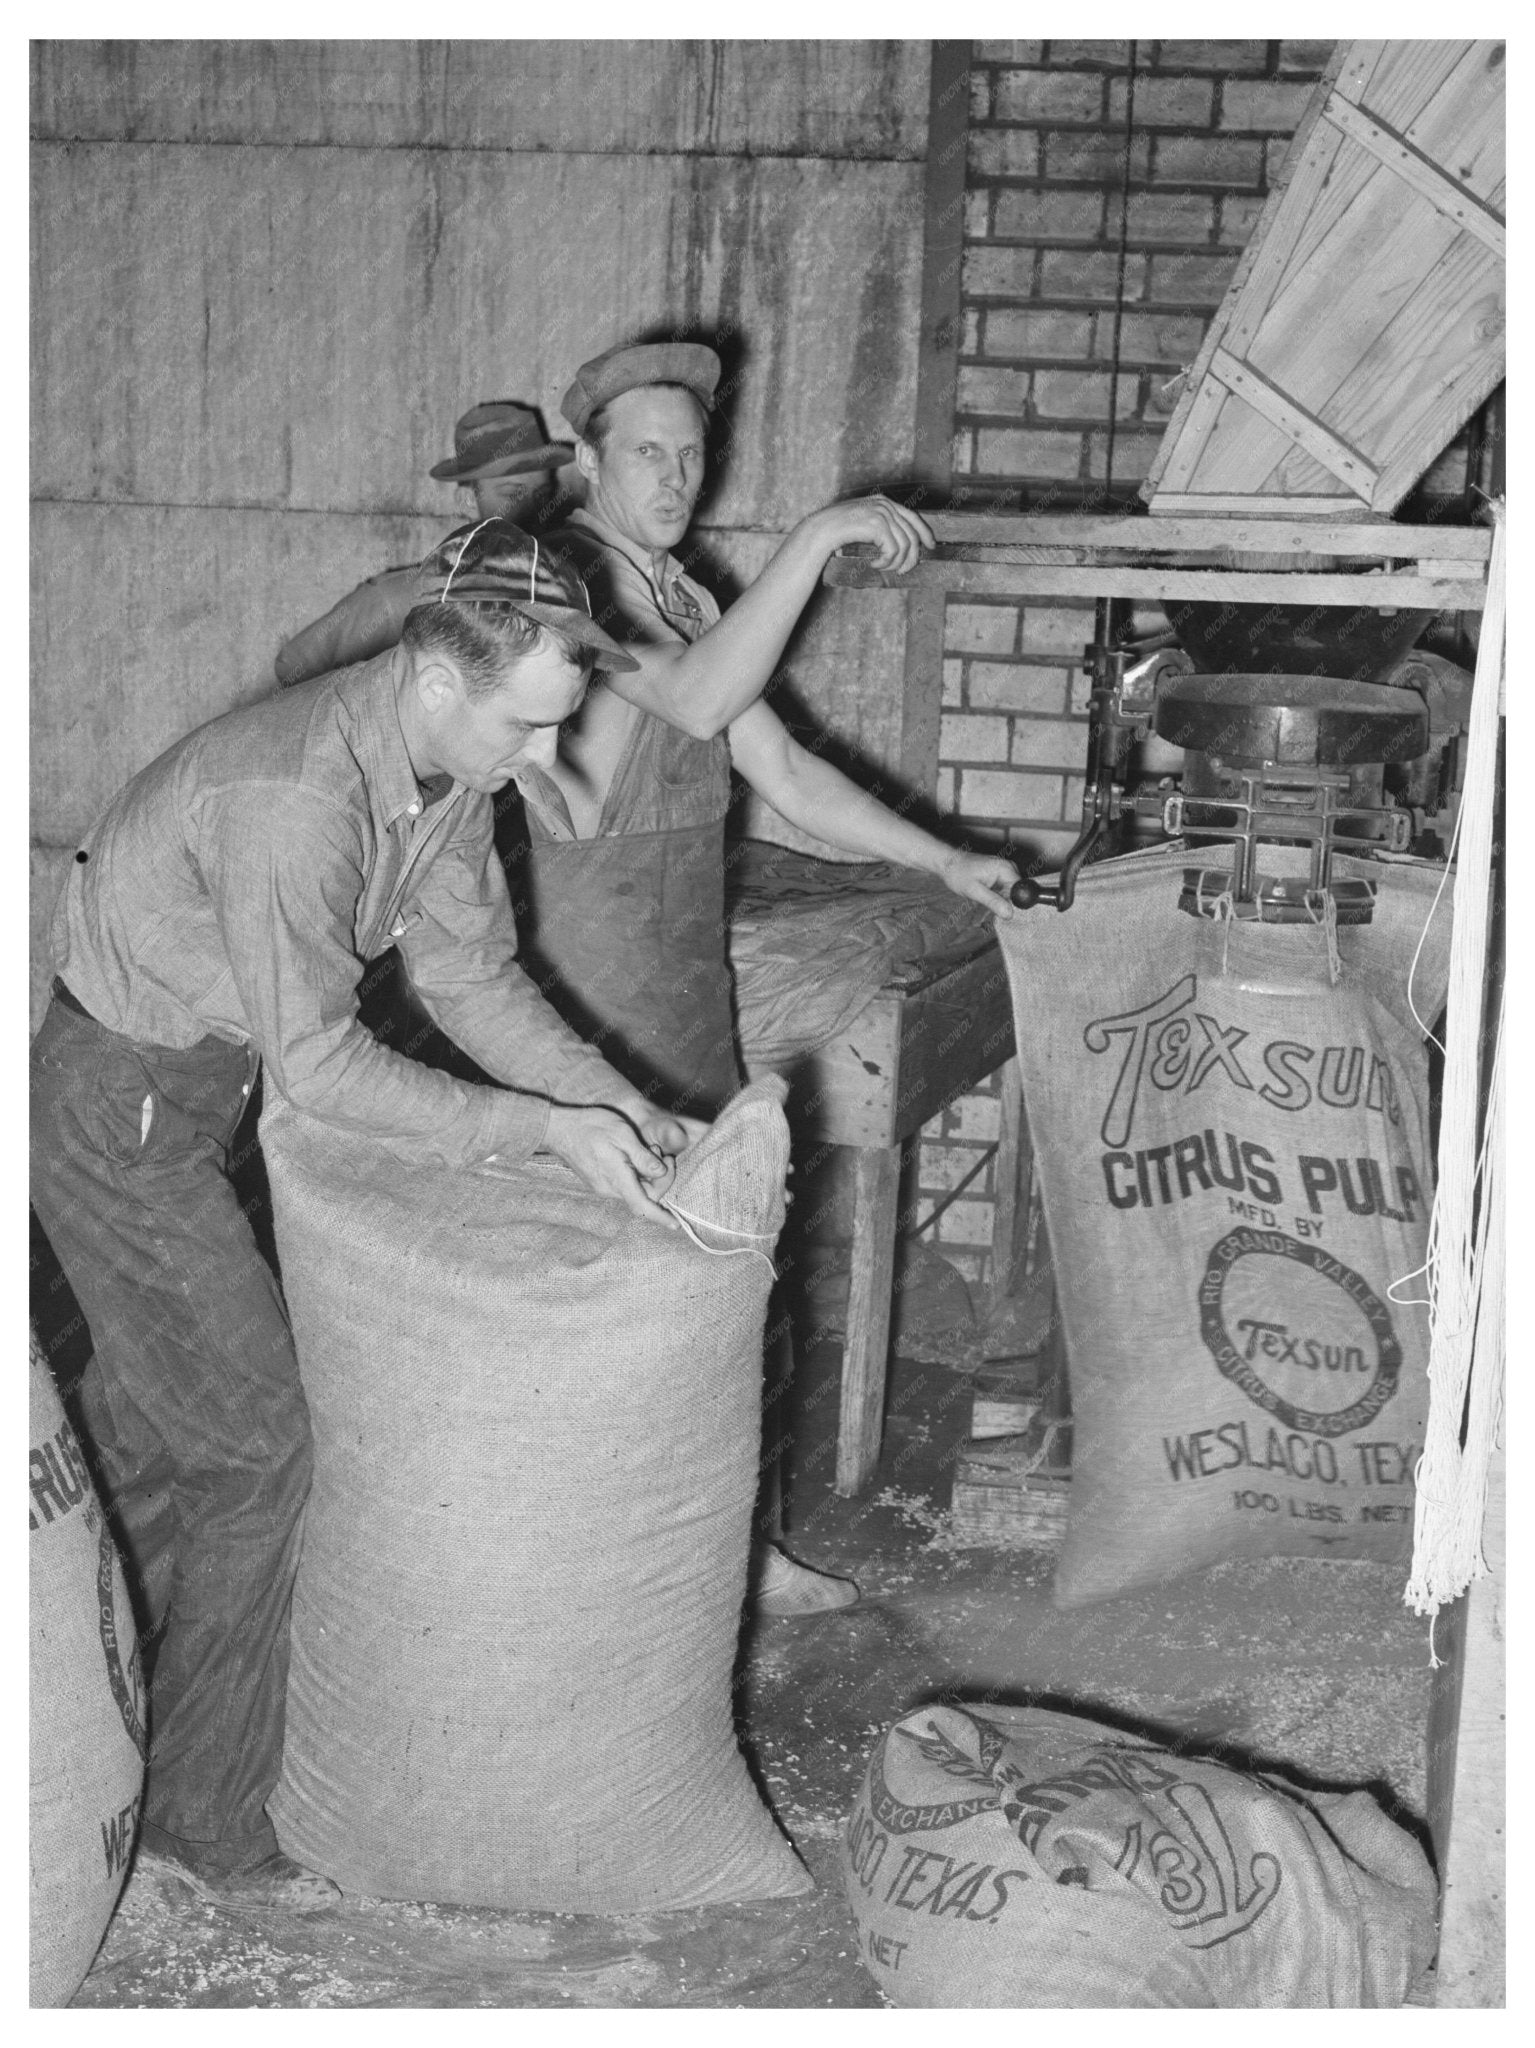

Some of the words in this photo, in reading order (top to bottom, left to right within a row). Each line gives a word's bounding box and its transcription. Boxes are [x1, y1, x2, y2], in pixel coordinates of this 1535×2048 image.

[1101, 1128, 1283, 1210] CITRUS
[1298, 1154, 1421, 1223] PULP
[1295, 1216, 1324, 1239] BY
[1203, 1269, 1223, 1306] RIO
[1217, 1234, 1299, 1262] GRANDE
[1313, 1251, 1388, 1322] VALLEY
[1295, 1370, 1397, 1433] EXCHANGE
[1353, 1440, 1425, 1486] TEX
[1233, 1490, 1280, 1513] 100
[1361, 1504, 1413, 1523] NET
[101, 1605, 117, 1650] RIO
[877, 1796, 1001, 1830] EXCHANG
[868, 1930, 909, 1971] NET
